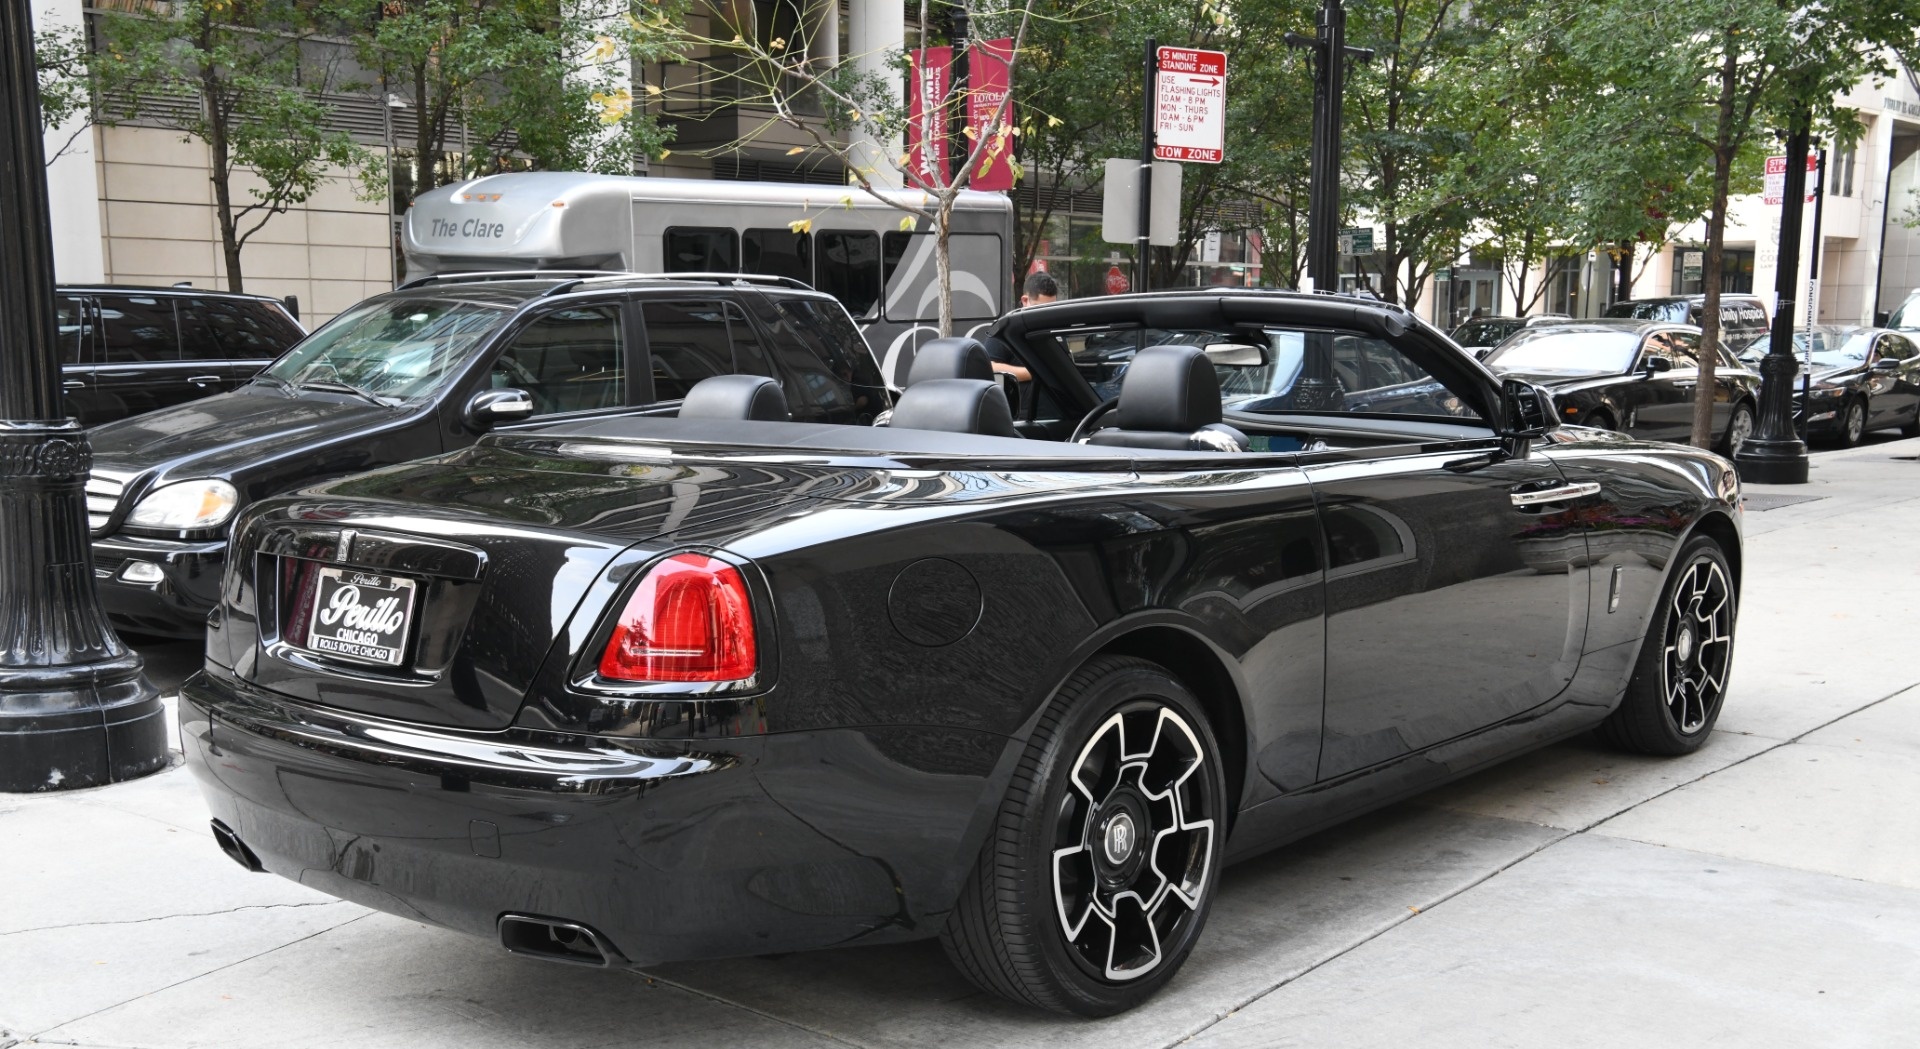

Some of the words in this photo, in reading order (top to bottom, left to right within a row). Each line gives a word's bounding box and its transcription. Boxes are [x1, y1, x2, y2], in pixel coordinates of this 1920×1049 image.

[1162, 51, 1170, 60] 15
[1171, 51, 1198, 62] MINUTE
[1162, 61, 1196, 72] STANDING
[1200, 64, 1218, 74] ZONE
[1161, 75, 1175, 84] USE
[1161, 85, 1195, 96] FLASHING
[1197, 88, 1221, 98] LIGHTS
[1161, 103, 1176, 112] MON
[1184, 105, 1208, 115] THURS
[1160, 122, 1172, 130] FRI
[1179, 123, 1194, 132] SUN
[1159, 146, 1182, 158] TOW
[1187, 148, 1217, 161] ZONE
[432, 218, 458, 237] The
[462, 218, 504, 239] Clare
[1720, 308, 1738, 324] Unity
[1738, 307, 1765, 323] Hospice
[1805, 281, 1814, 338] CONSIGNMENT
[1803, 340, 1811, 373] VEHICLE
[350, 572, 382, 586] Perillo
[320, 584, 404, 635] Perillo
[336, 628, 379, 646] CHICAGO
[320, 638, 338, 651] ROLLS
[339, 642, 359, 655] ROYCE
[360, 646, 388, 660] CHICAGO
